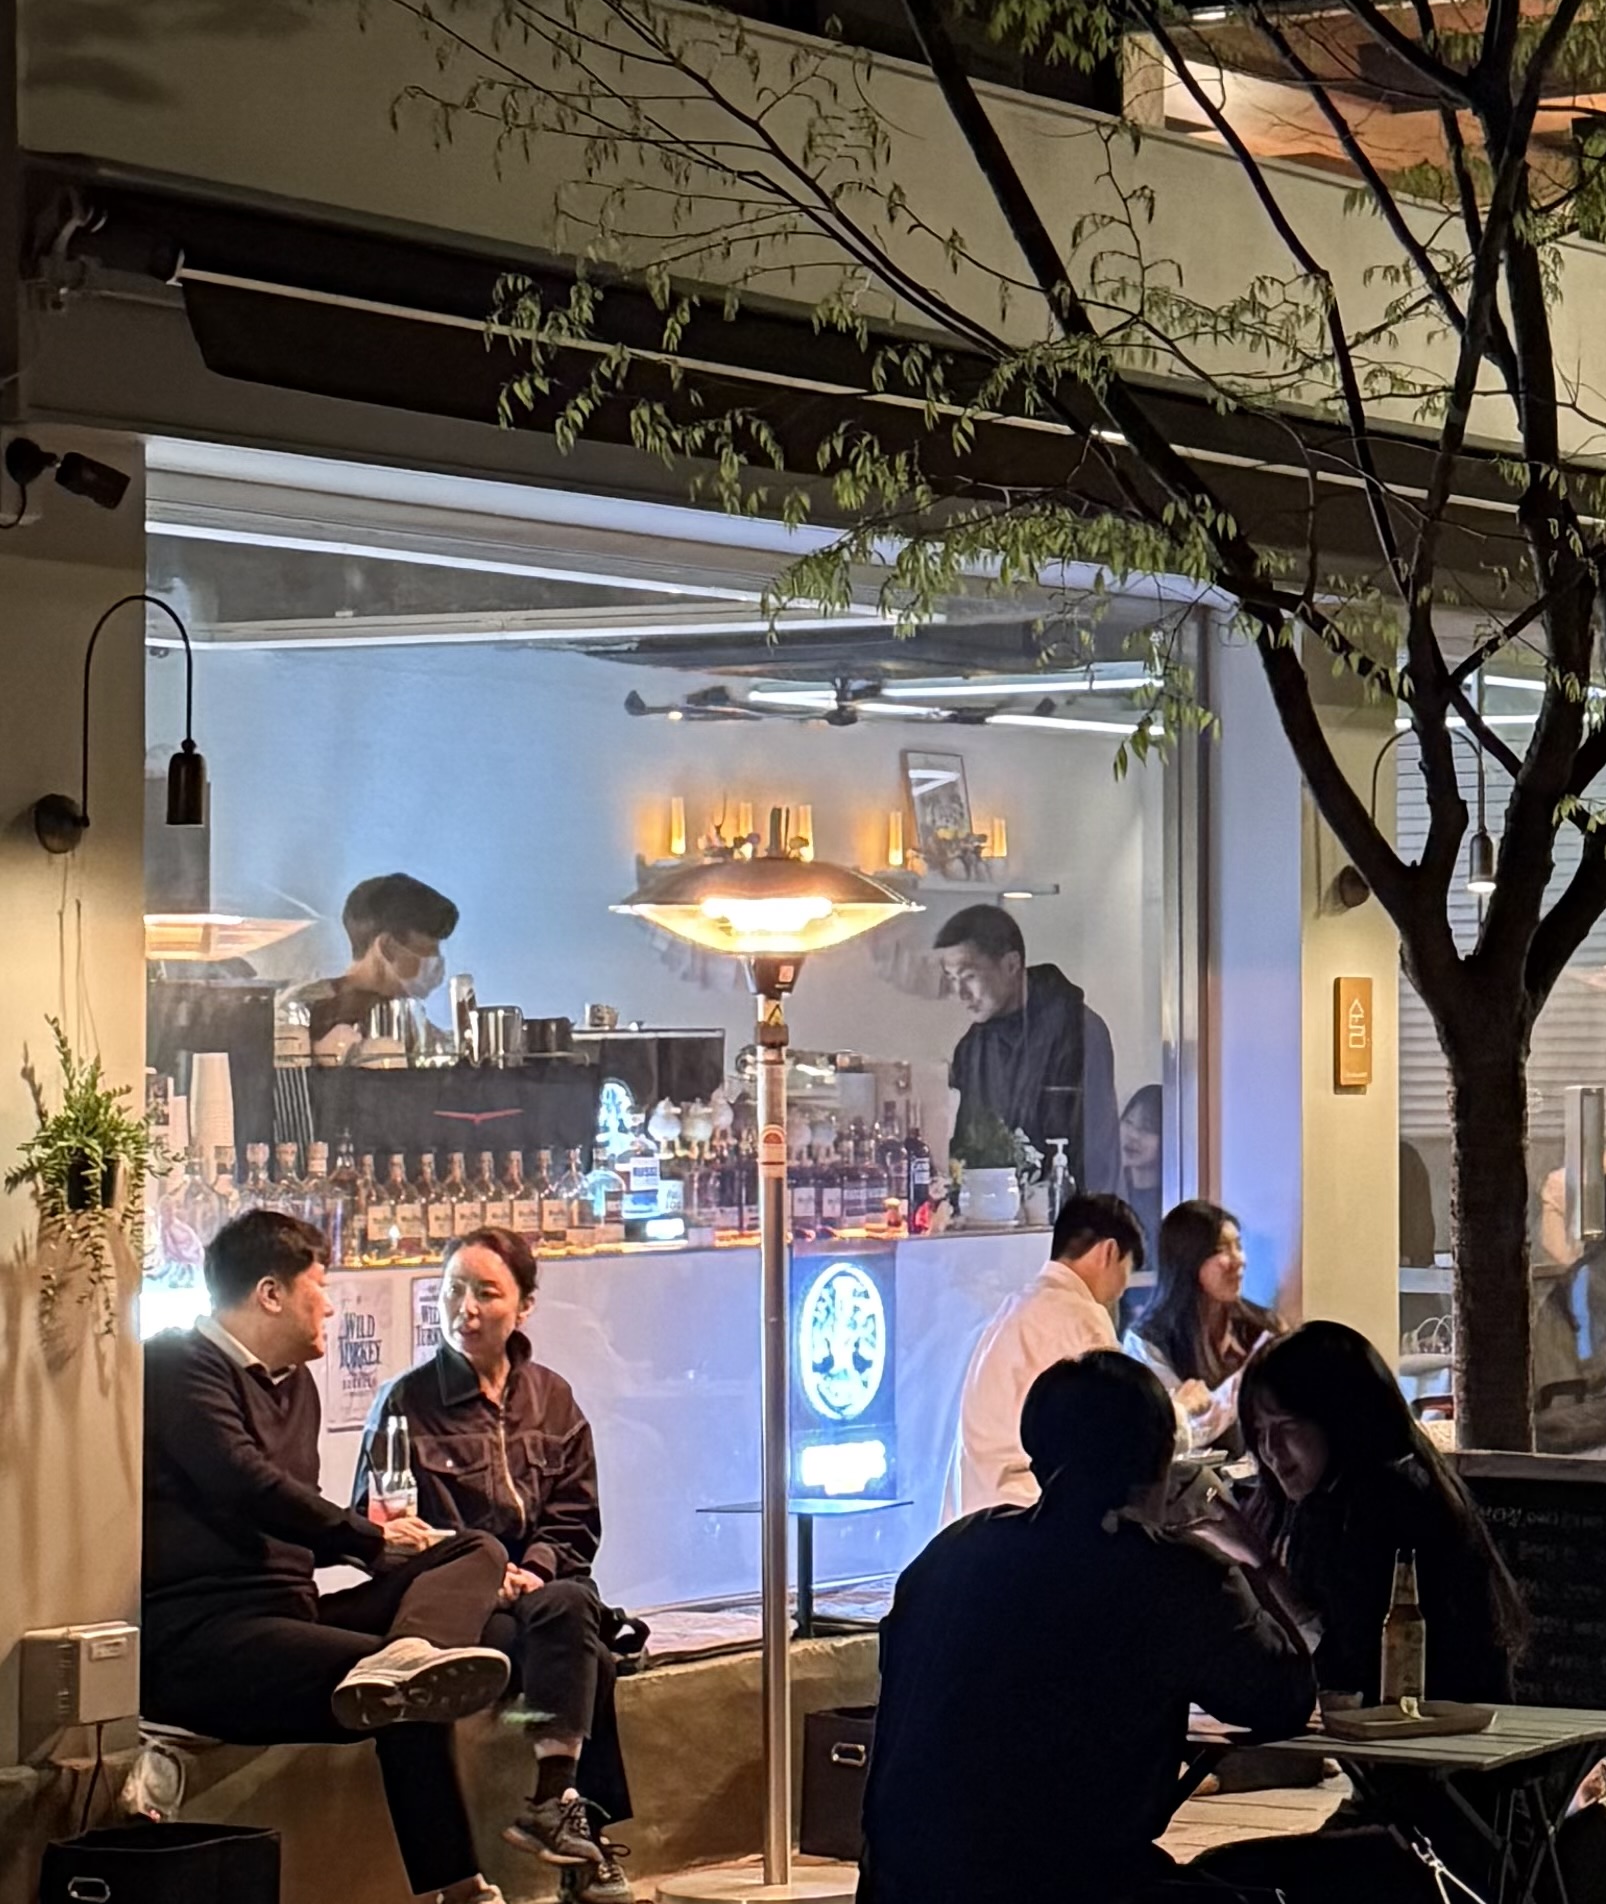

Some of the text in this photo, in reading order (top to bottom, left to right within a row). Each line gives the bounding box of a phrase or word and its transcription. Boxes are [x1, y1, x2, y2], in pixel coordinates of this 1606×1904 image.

[343, 1312, 376, 1339] WILD
[421, 1305, 441, 1325] WIL
[338, 1337, 382, 1369] TURKEY
